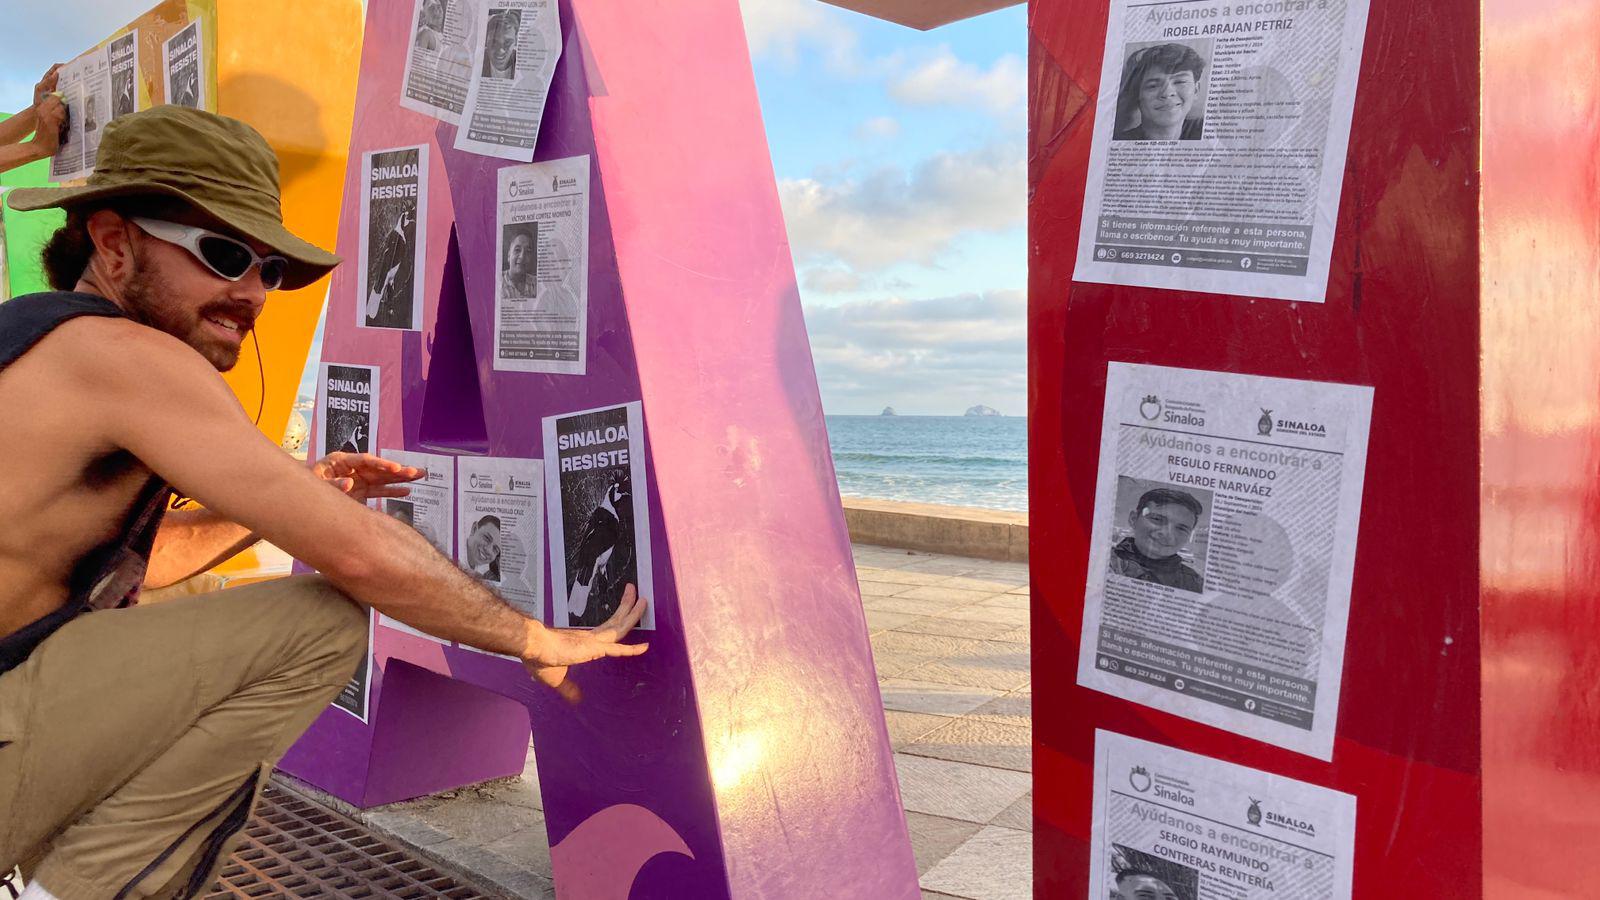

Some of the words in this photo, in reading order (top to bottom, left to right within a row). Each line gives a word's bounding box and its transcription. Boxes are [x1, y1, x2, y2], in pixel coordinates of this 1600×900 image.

[1146, 6, 1218, 25] Ayúdanos
[1222, 6, 1231, 16] a
[1235, 0, 1312, 16] encontrar
[1163, 26, 1199, 37] IROBEL
[1202, 22, 1252, 35] ABRAJAN
[1254, 19, 1293, 31] PETRIZ
[111, 44, 134, 62] SINALOA
[168, 34, 198, 61] SINALOA
[112, 58, 134, 75] RESISTE
[170, 50, 198, 76] RESISTE
[372, 164, 418, 180] SINALOA
[372, 184, 417, 200] RESISTE
[1100, 230, 1120, 239] llama
[1179, 234, 1188, 242] Tu
[1191, 236, 1216, 245] ayuda
[1232, 239, 1250, 248] muy
[1253, 240, 1305, 250] importante.
[1102, 220, 1109, 228] Si
[1112, 221, 1136, 230] tienes
[1140, 222, 1188, 232] información
[1192, 224, 1230, 234] referente
[1244, 228, 1262, 236] esta
[1266, 229, 1307, 239] persona,
[328, 379, 370, 395] SINALOA
[328, 396, 369, 413] RESISTE
[1164, 410, 1204, 426] Sinaloa
[1277, 420, 1326, 432] SINALOA
[559, 426, 629, 450] SINALOA
[562, 449, 628, 472] RESISTE
[1140, 432, 1212, 454] Ayúdanos
[1216, 446, 1224, 456] a
[1230, 447, 1308, 468] encontrar
[1312, 460, 1322, 470] a
[1168, 455, 1210, 470] REGULO
[1214, 462, 1276, 480] FERNANDO
[1169, 472, 1216, 488] VELARDE
[1219, 480, 1272, 498] NARVÁEZ
[1102, 630, 1110, 638] Si
[1114, 634, 1137, 646] tienes
[1141, 641, 1190, 660] información
[1194, 656, 1234, 672] referente
[1246, 670, 1266, 680] esta
[1182, 661, 1191, 670] Tu
[1194, 668, 1220, 679] ayuda
[1222, 674, 1232, 682] es
[1234, 678, 1254, 689] muy
[1256, 682, 1310, 704] importante.
[1154, 784, 1194, 807] Sinaloa
[1266, 812, 1314, 832] SINALOA
[1130, 802, 1202, 835] Ayúdanos
[1208, 828, 1216, 839] a
[1221, 832, 1299, 864] encontrar
[1304, 858, 1314, 870] a
[1160, 830, 1198, 850] SERGIO
[1201, 842, 1270, 872] RAYMUNDO
[1154, 844, 1216, 872] CONTRERAS
[1220, 864, 1274, 892] RENTERÍA
